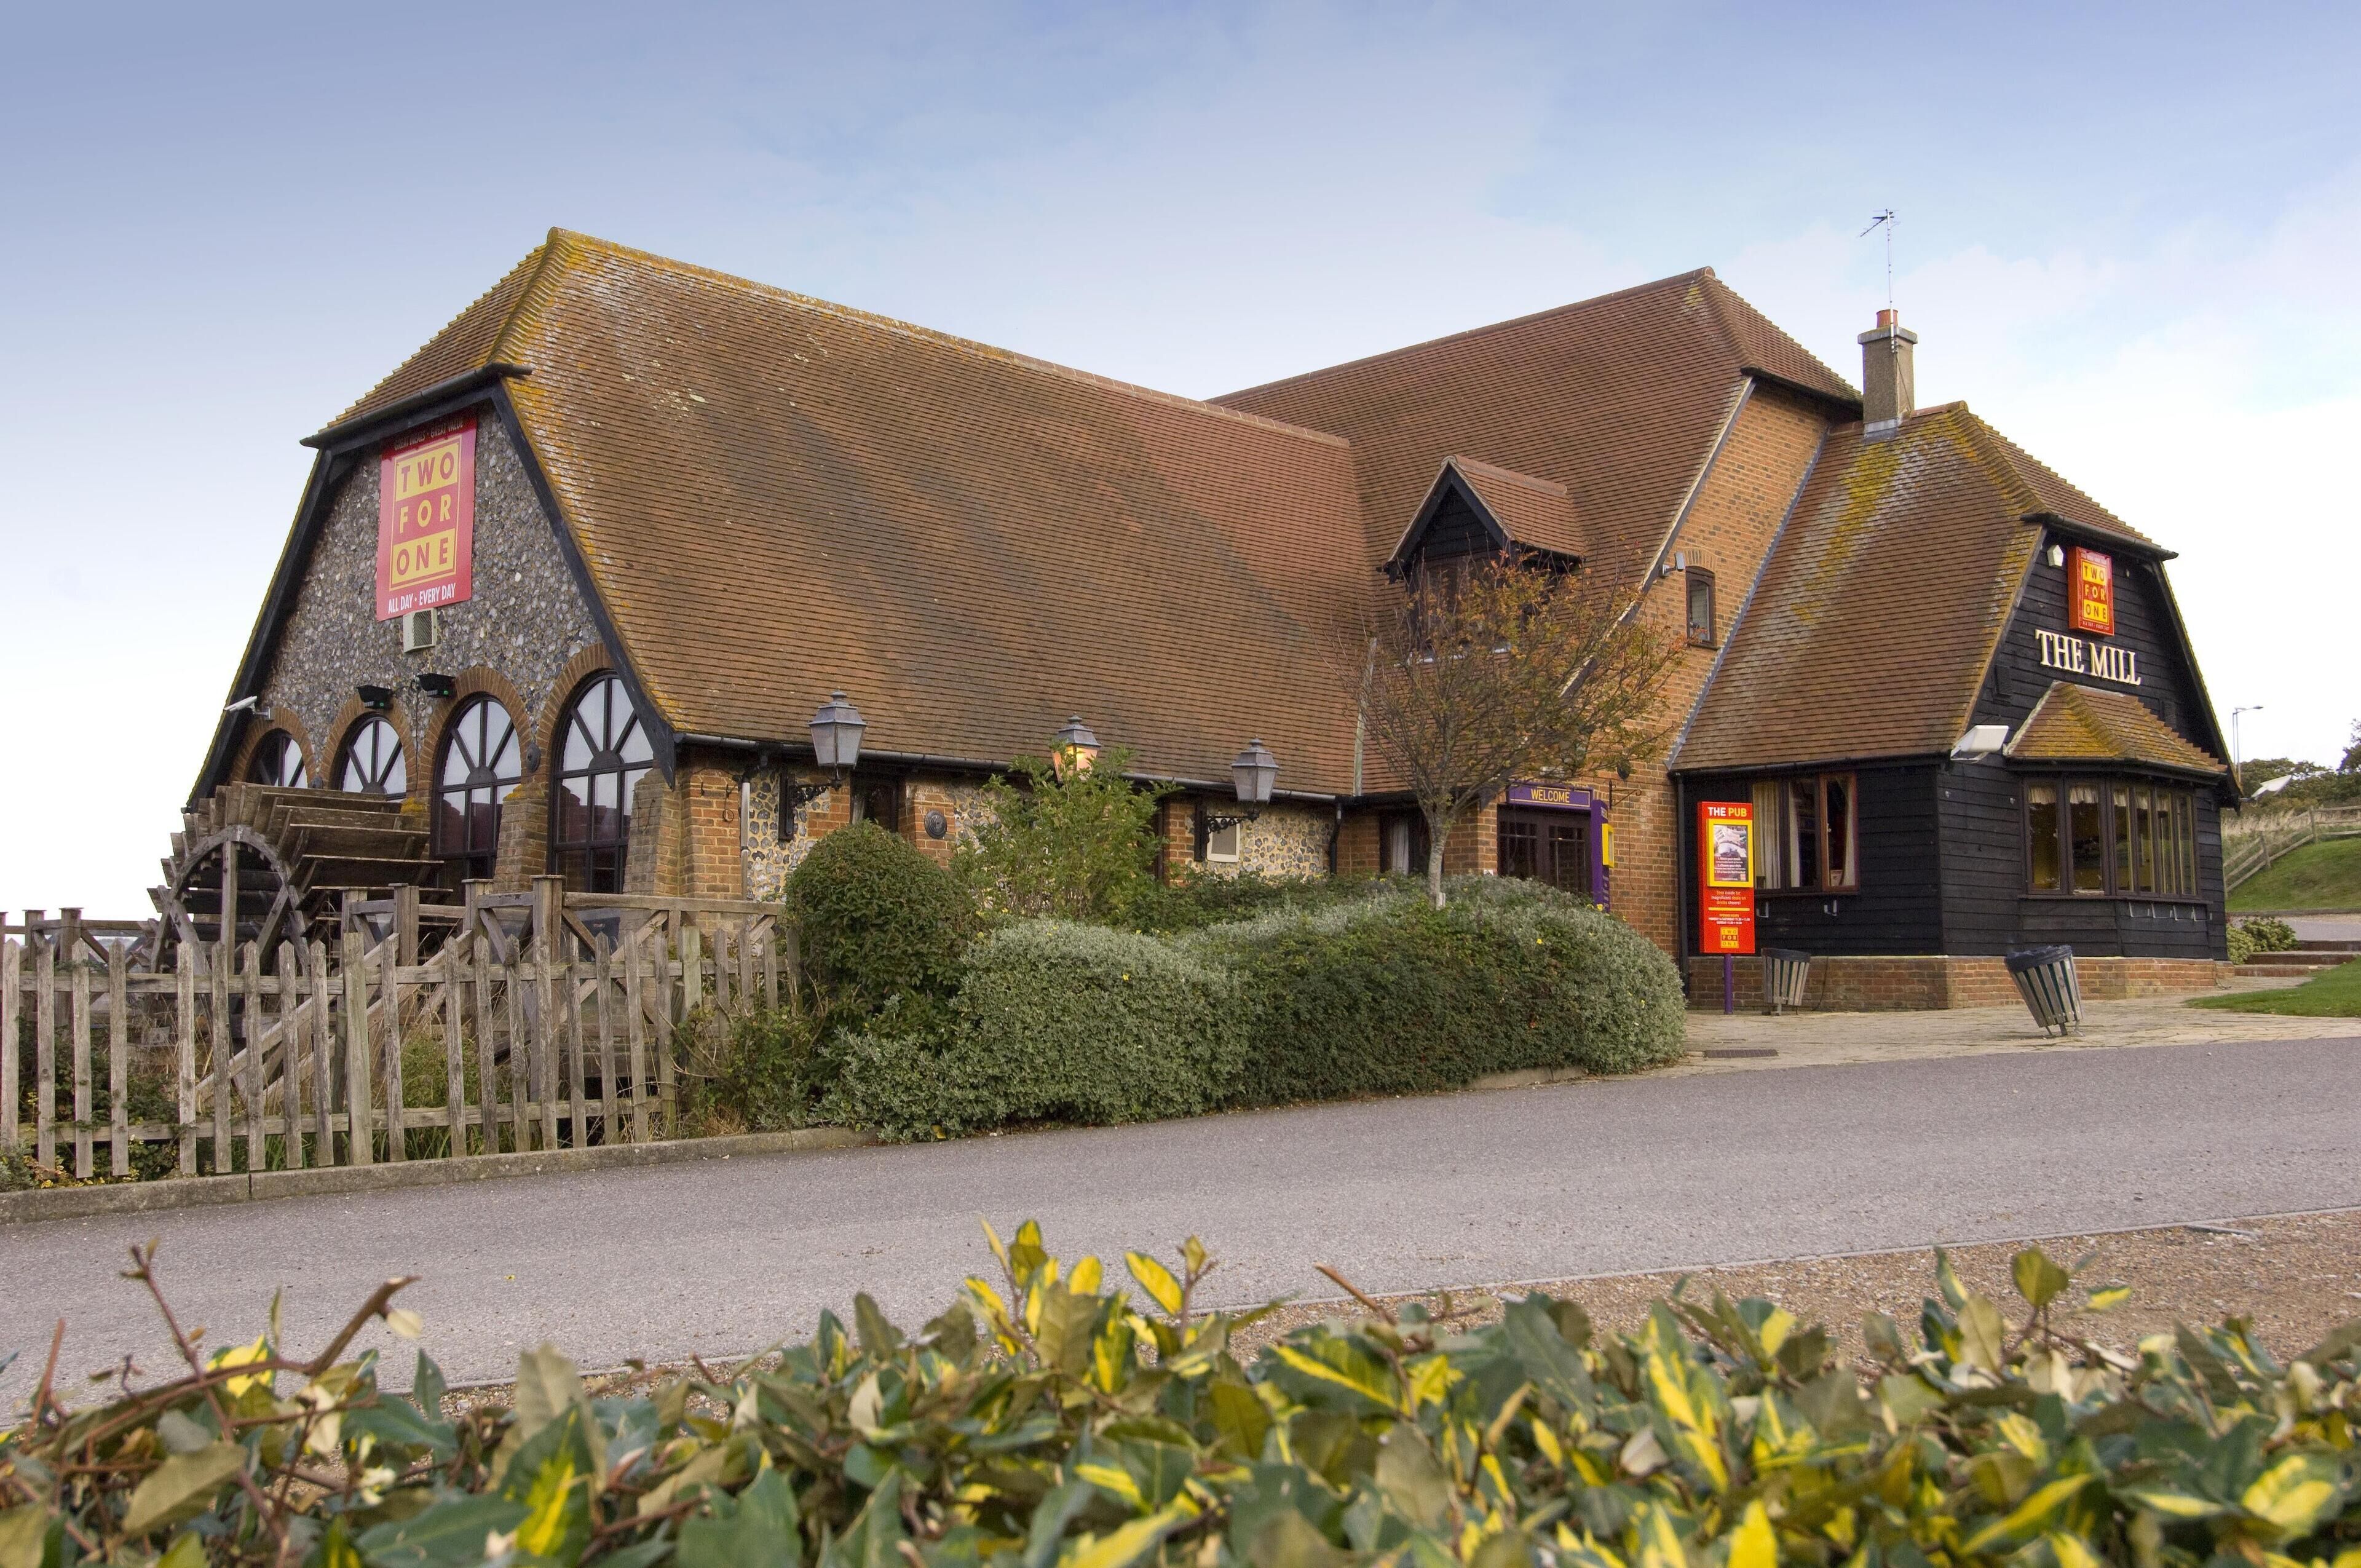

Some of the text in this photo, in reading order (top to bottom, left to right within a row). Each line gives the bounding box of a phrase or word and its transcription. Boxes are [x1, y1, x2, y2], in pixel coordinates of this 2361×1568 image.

[430, 423, 446, 438] GREAT
[448, 418, 463, 432] VALUE
[401, 451, 454, 493] TWO
[399, 494, 451, 534] FOR
[397, 537, 449, 576] ONE
[2084, 565, 2105, 582] TWO
[388, 583, 456, 614] ALL DAY EVERY DAY
[2084, 584, 2106, 601] FOR
[2085, 603, 2106, 619] ONE
[2035, 629, 2141, 686] THE MILL
[1531, 788, 1570, 803] WELCOME
[1707, 806, 1747, 817] THE PUB
